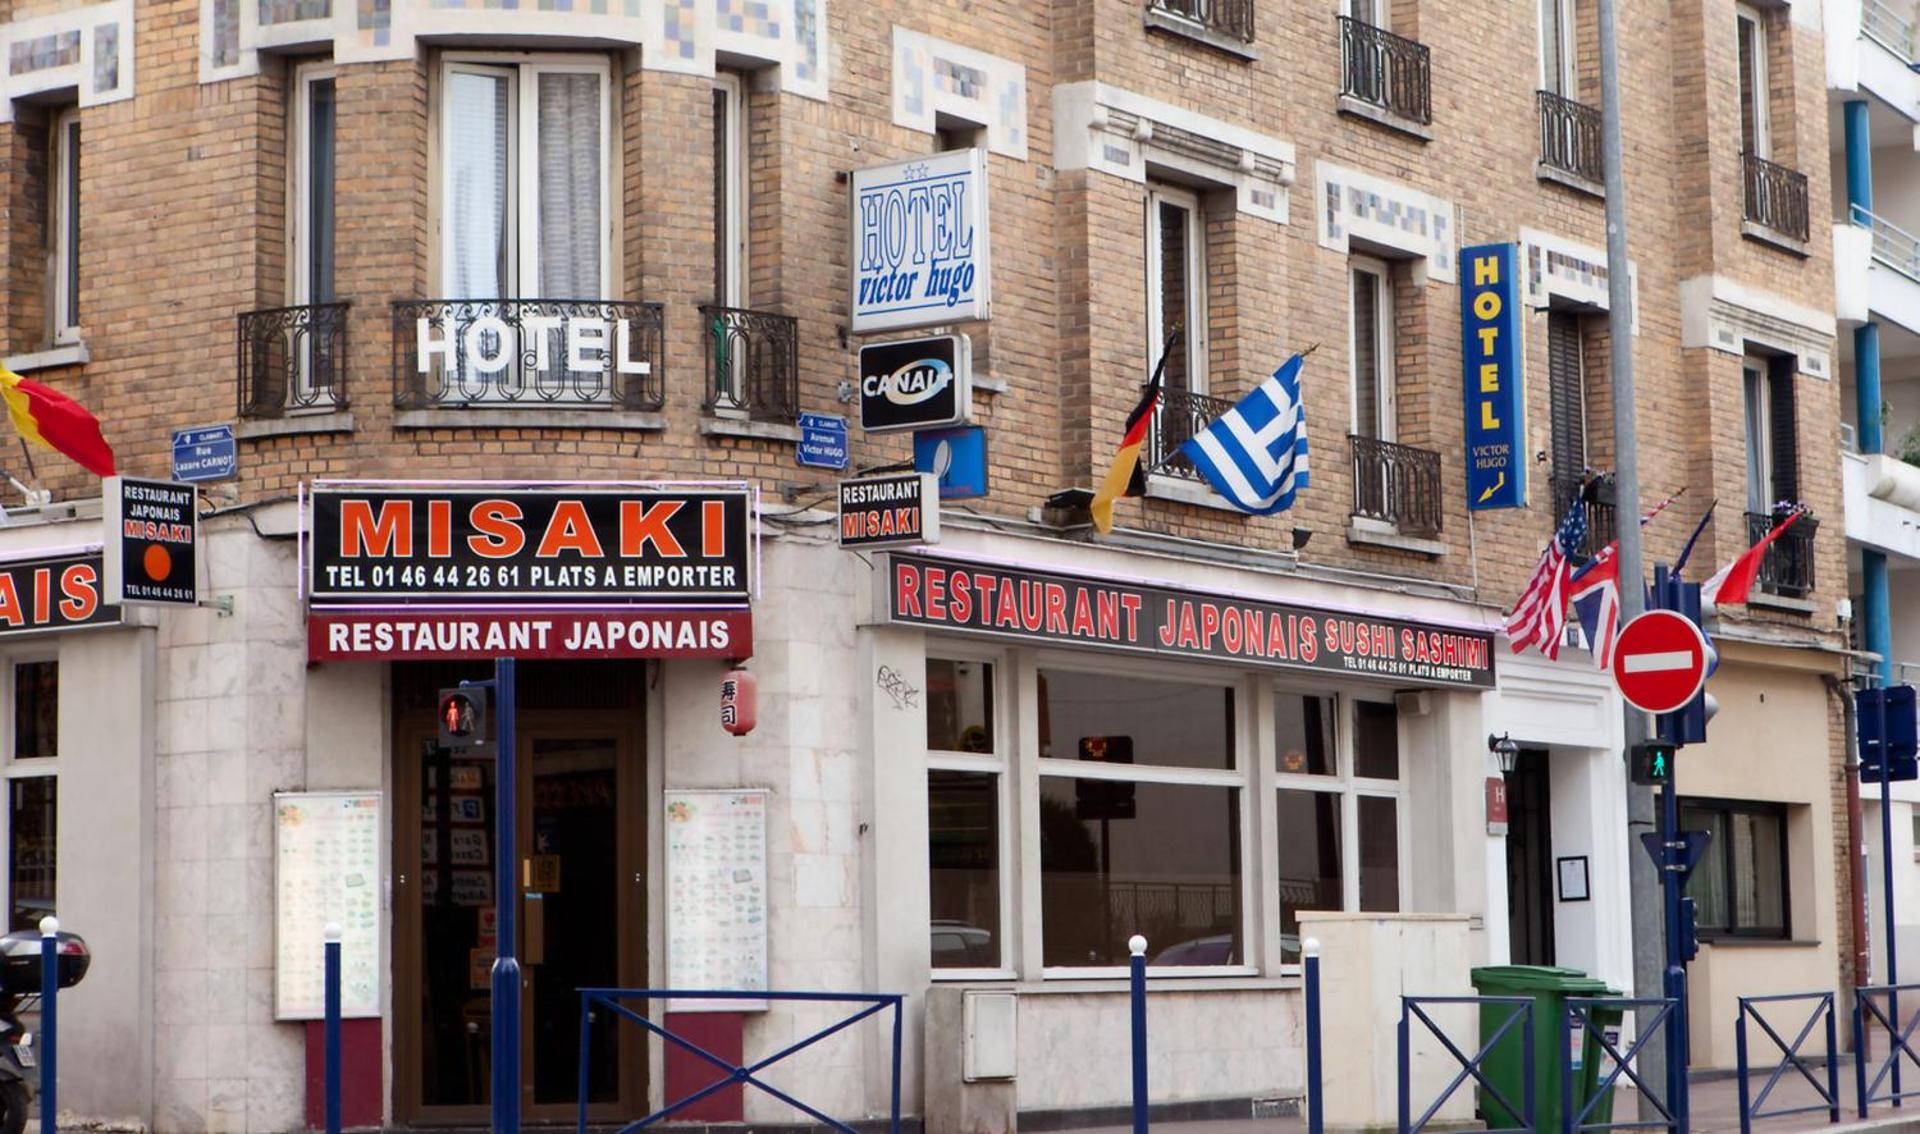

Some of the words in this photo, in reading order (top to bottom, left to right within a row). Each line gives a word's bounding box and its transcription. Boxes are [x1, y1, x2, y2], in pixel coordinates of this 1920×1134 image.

[860, 181, 974, 272] HOTEL
[857, 264, 918, 305] victor
[925, 257, 975, 307] hugo
[417, 317, 650, 374] HOTEL
[1473, 256, 1502, 431] HOTEL
[810, 432, 835, 444] Avenue
[196, 446, 211, 456] Rue
[201, 455, 232, 468] CARNOT
[803, 444, 822, 455] Victor
[823, 446, 844, 457] HUGO
[1473, 445, 1509, 457] VICTOR
[1476, 457, 1506, 468] HUGO
[124, 485, 191, 505] RESTAURANT
[842, 481, 919, 504] RESTAURANT
[130, 503, 181, 520] JAPONAIS
[843, 507, 919, 538] MISAKI
[124, 518, 192, 543] MISAKI
[340, 499, 725, 558] MISAKI
[327, 566, 365, 586] TEL
[372, 566, 394, 586] 01
[401, 566, 426, 587] 46
[433, 566, 459, 587] 44
[466, 566, 490, 586] 26
[497, 566, 519, 586] 61
[531, 566, 596, 586] PLATS
[604, 566, 617, 586] A
[624, 566, 736, 587] EMPORTER
[127, 584, 140, 595] TEL
[897, 563, 1142, 642] RESTAURANT
[1159, 599, 1318, 664] JAPONAIS
[1325, 619, 1395, 658] SUSHI
[1402, 630, 1488, 669] SASHIMI
[329, 622, 552, 652] RESTAURANT
[564, 620, 730, 650] JAPONAIS
[1343, 656, 1357, 668] TEL
[1408, 663, 1430, 677] PLATS
[1436, 667, 1473, 681] EMPORTER
[720, 680, 738, 725] 寿司
[1495, 786, 1505, 803] H
